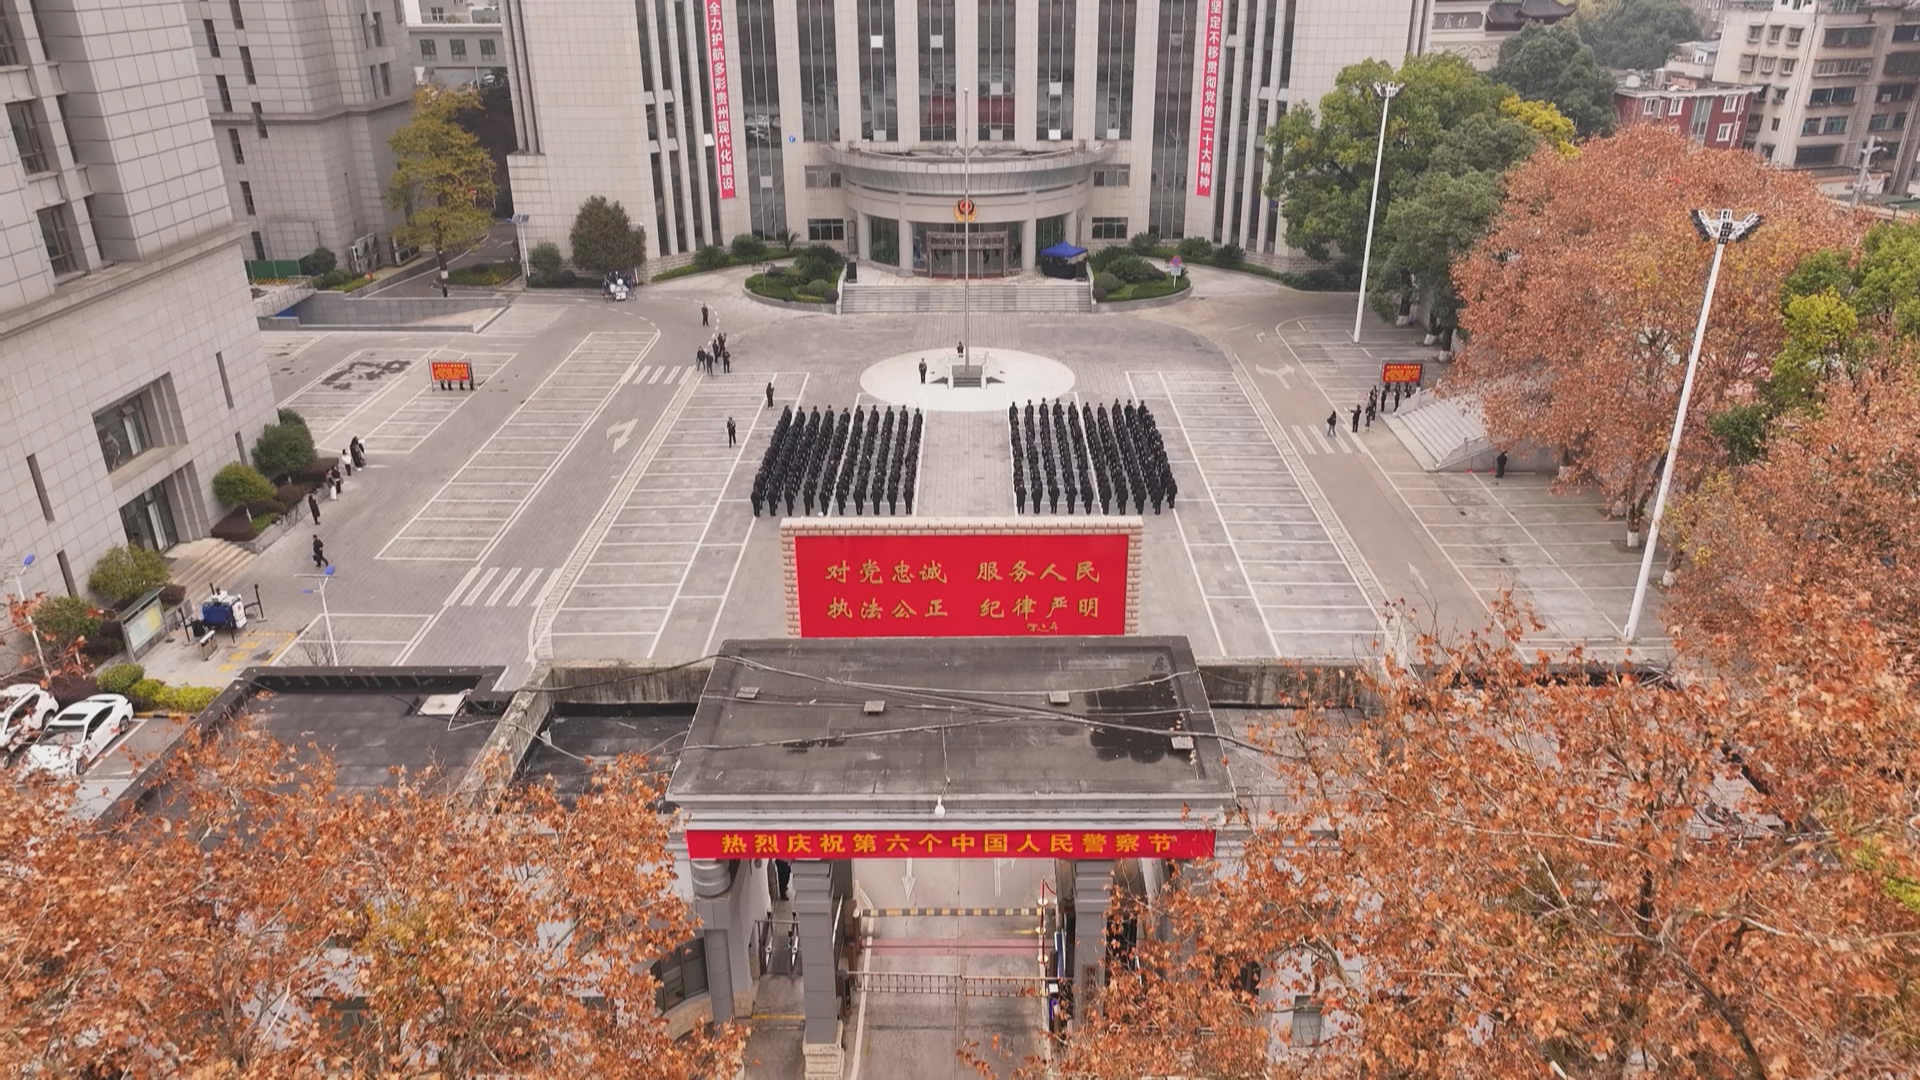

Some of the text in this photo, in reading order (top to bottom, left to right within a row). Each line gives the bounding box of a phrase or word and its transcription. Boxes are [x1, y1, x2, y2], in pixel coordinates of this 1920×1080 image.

[708, 1, 734, 190] 全力护航多彩贵州现代化建设
[1199, 0, 1222, 188] 坚定不移贯彻党的二十大精神
[825, 559, 1100, 584] 对党忠诚 服务人民
[827, 595, 1099, 620] 执法公正 纪律严明
[721, 833, 1173, 853] 热烈庆祝第六个中国人民警察节
